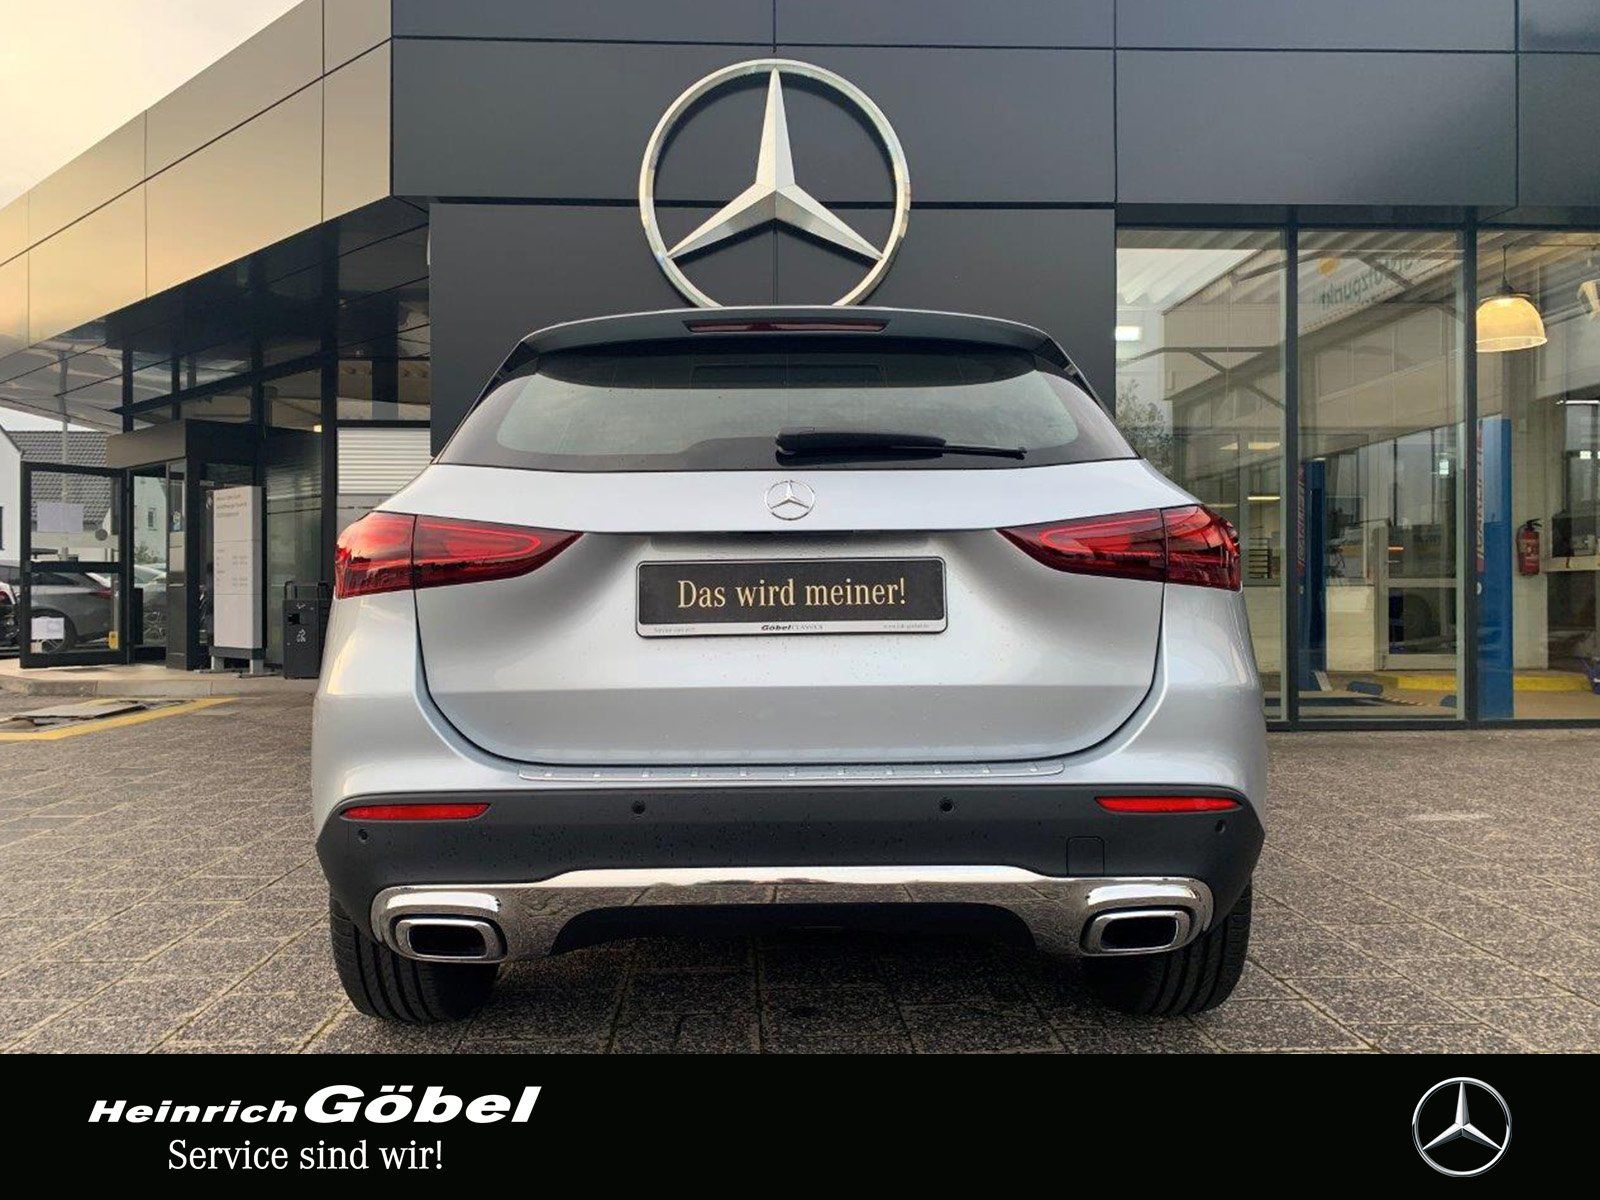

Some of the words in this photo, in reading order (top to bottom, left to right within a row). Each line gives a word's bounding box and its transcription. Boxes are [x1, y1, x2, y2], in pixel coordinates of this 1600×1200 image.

[677, 580, 725, 608] Das
[736, 578, 796, 607] wird
[805, 577, 906, 606] meiner!
